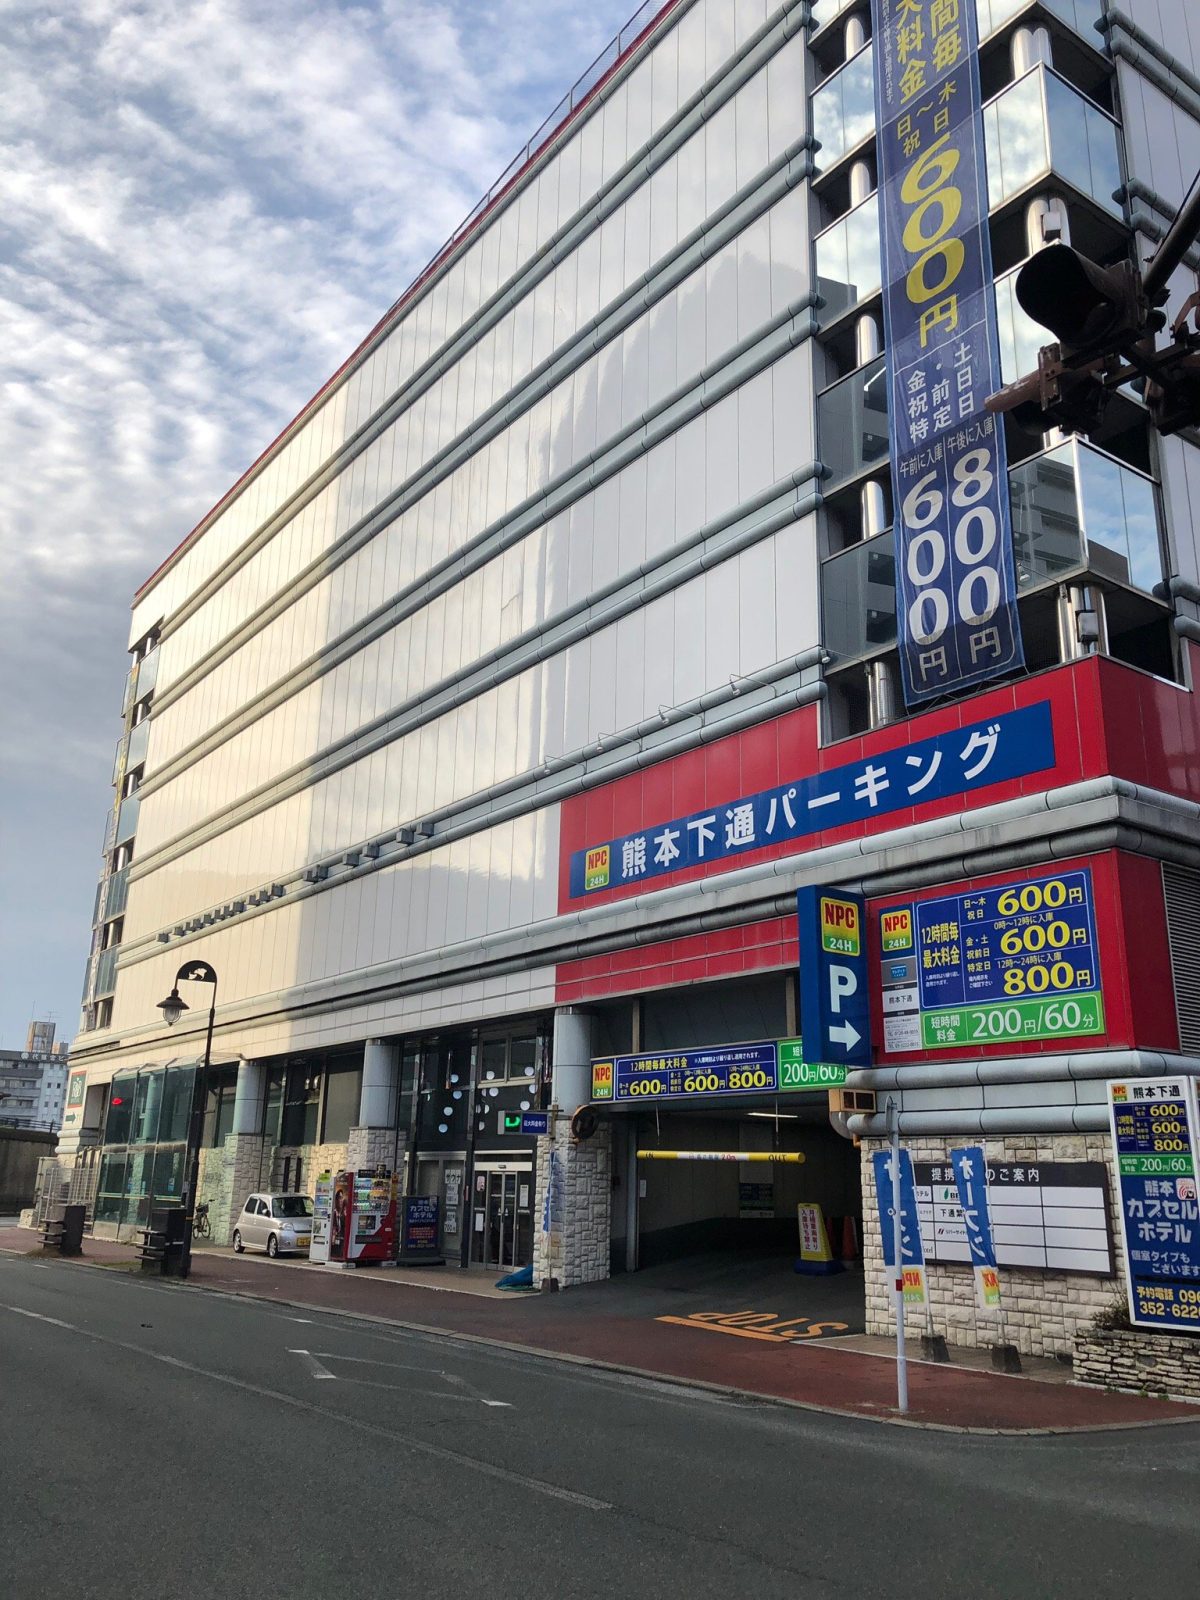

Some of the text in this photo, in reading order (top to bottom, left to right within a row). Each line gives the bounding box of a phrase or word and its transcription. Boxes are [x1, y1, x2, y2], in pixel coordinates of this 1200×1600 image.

[947, 416, 994, 455] 午後に入庫
[900, 442, 943, 478] 午前に入庫
[621, 723, 1001, 879] 熊本下通パーキング
[588, 850, 607, 870] NPC
[590, 875, 604, 886] 24H
[997, 881, 1083, 915] 600円
[825, 903, 855, 929] NPC
[884, 914, 908, 932] NPC
[967, 909, 984, 920] 祝日
[921, 921, 959, 944] 12時間毎
[1000, 920, 1087, 955] 600円
[829, 938, 852, 951] 24H
[889, 938, 906, 949] 24H
[923, 945, 960, 968] 最大料金
[967, 948, 990, 959] 祝前日
[967, 961, 991, 972] 特定日
[1003, 961, 1091, 995] 800円
[829, 964, 858, 1014] P
[931, 1015, 960, 1029] 短時間
[936, 1030, 957, 1042] 料金
[631, 1057, 688, 1071] 12時間毎最大料金
[594, 1066, 611, 1081] NPC
[728, 1070, 774, 1089] 800円
[596, 1088, 609, 1096] 24H
[629, 1079, 667, 1096] 600円
[684, 1074, 726, 1092] 600円
[1133, 1085, 1180, 1099] 熊本下通
[1144, 1180, 1174, 1197] 熊本
[1127, 1199, 1198, 1220] カプセル
[1138, 1222, 1192, 1243] ホテル
[1136, 1286, 1174, 1301] 予約電話
[688, 1310, 849, 1337] STOP
